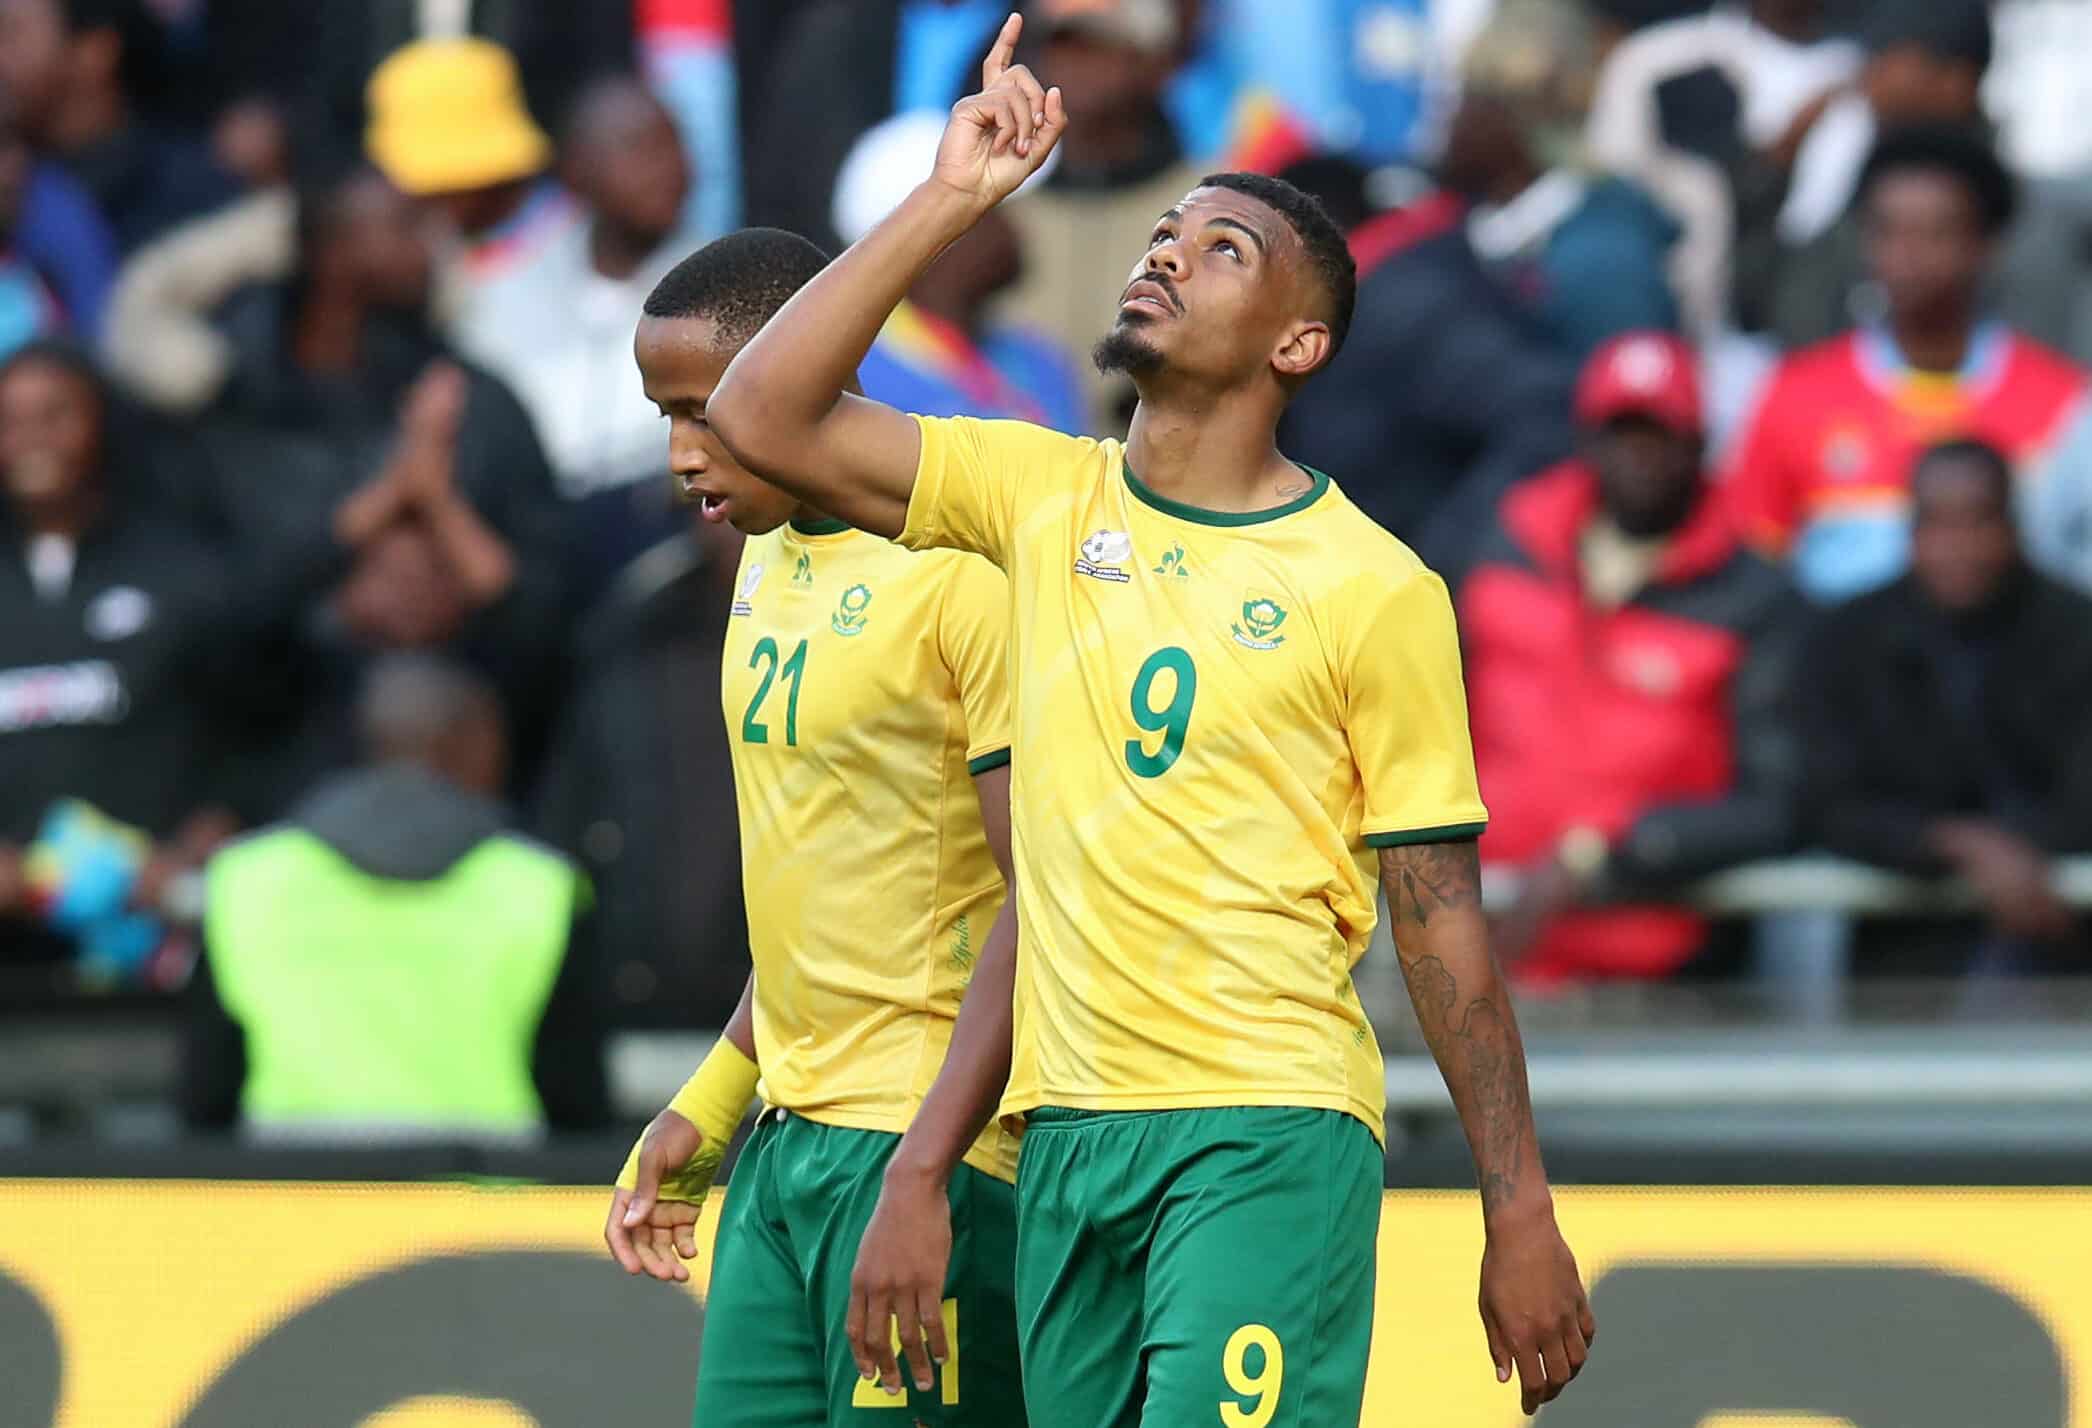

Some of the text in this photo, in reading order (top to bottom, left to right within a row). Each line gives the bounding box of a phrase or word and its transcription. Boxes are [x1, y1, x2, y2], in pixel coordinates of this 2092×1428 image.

[743, 636, 808, 747] 21
[1125, 646, 1197, 778] 9
[1219, 1323, 1284, 1428] 9
